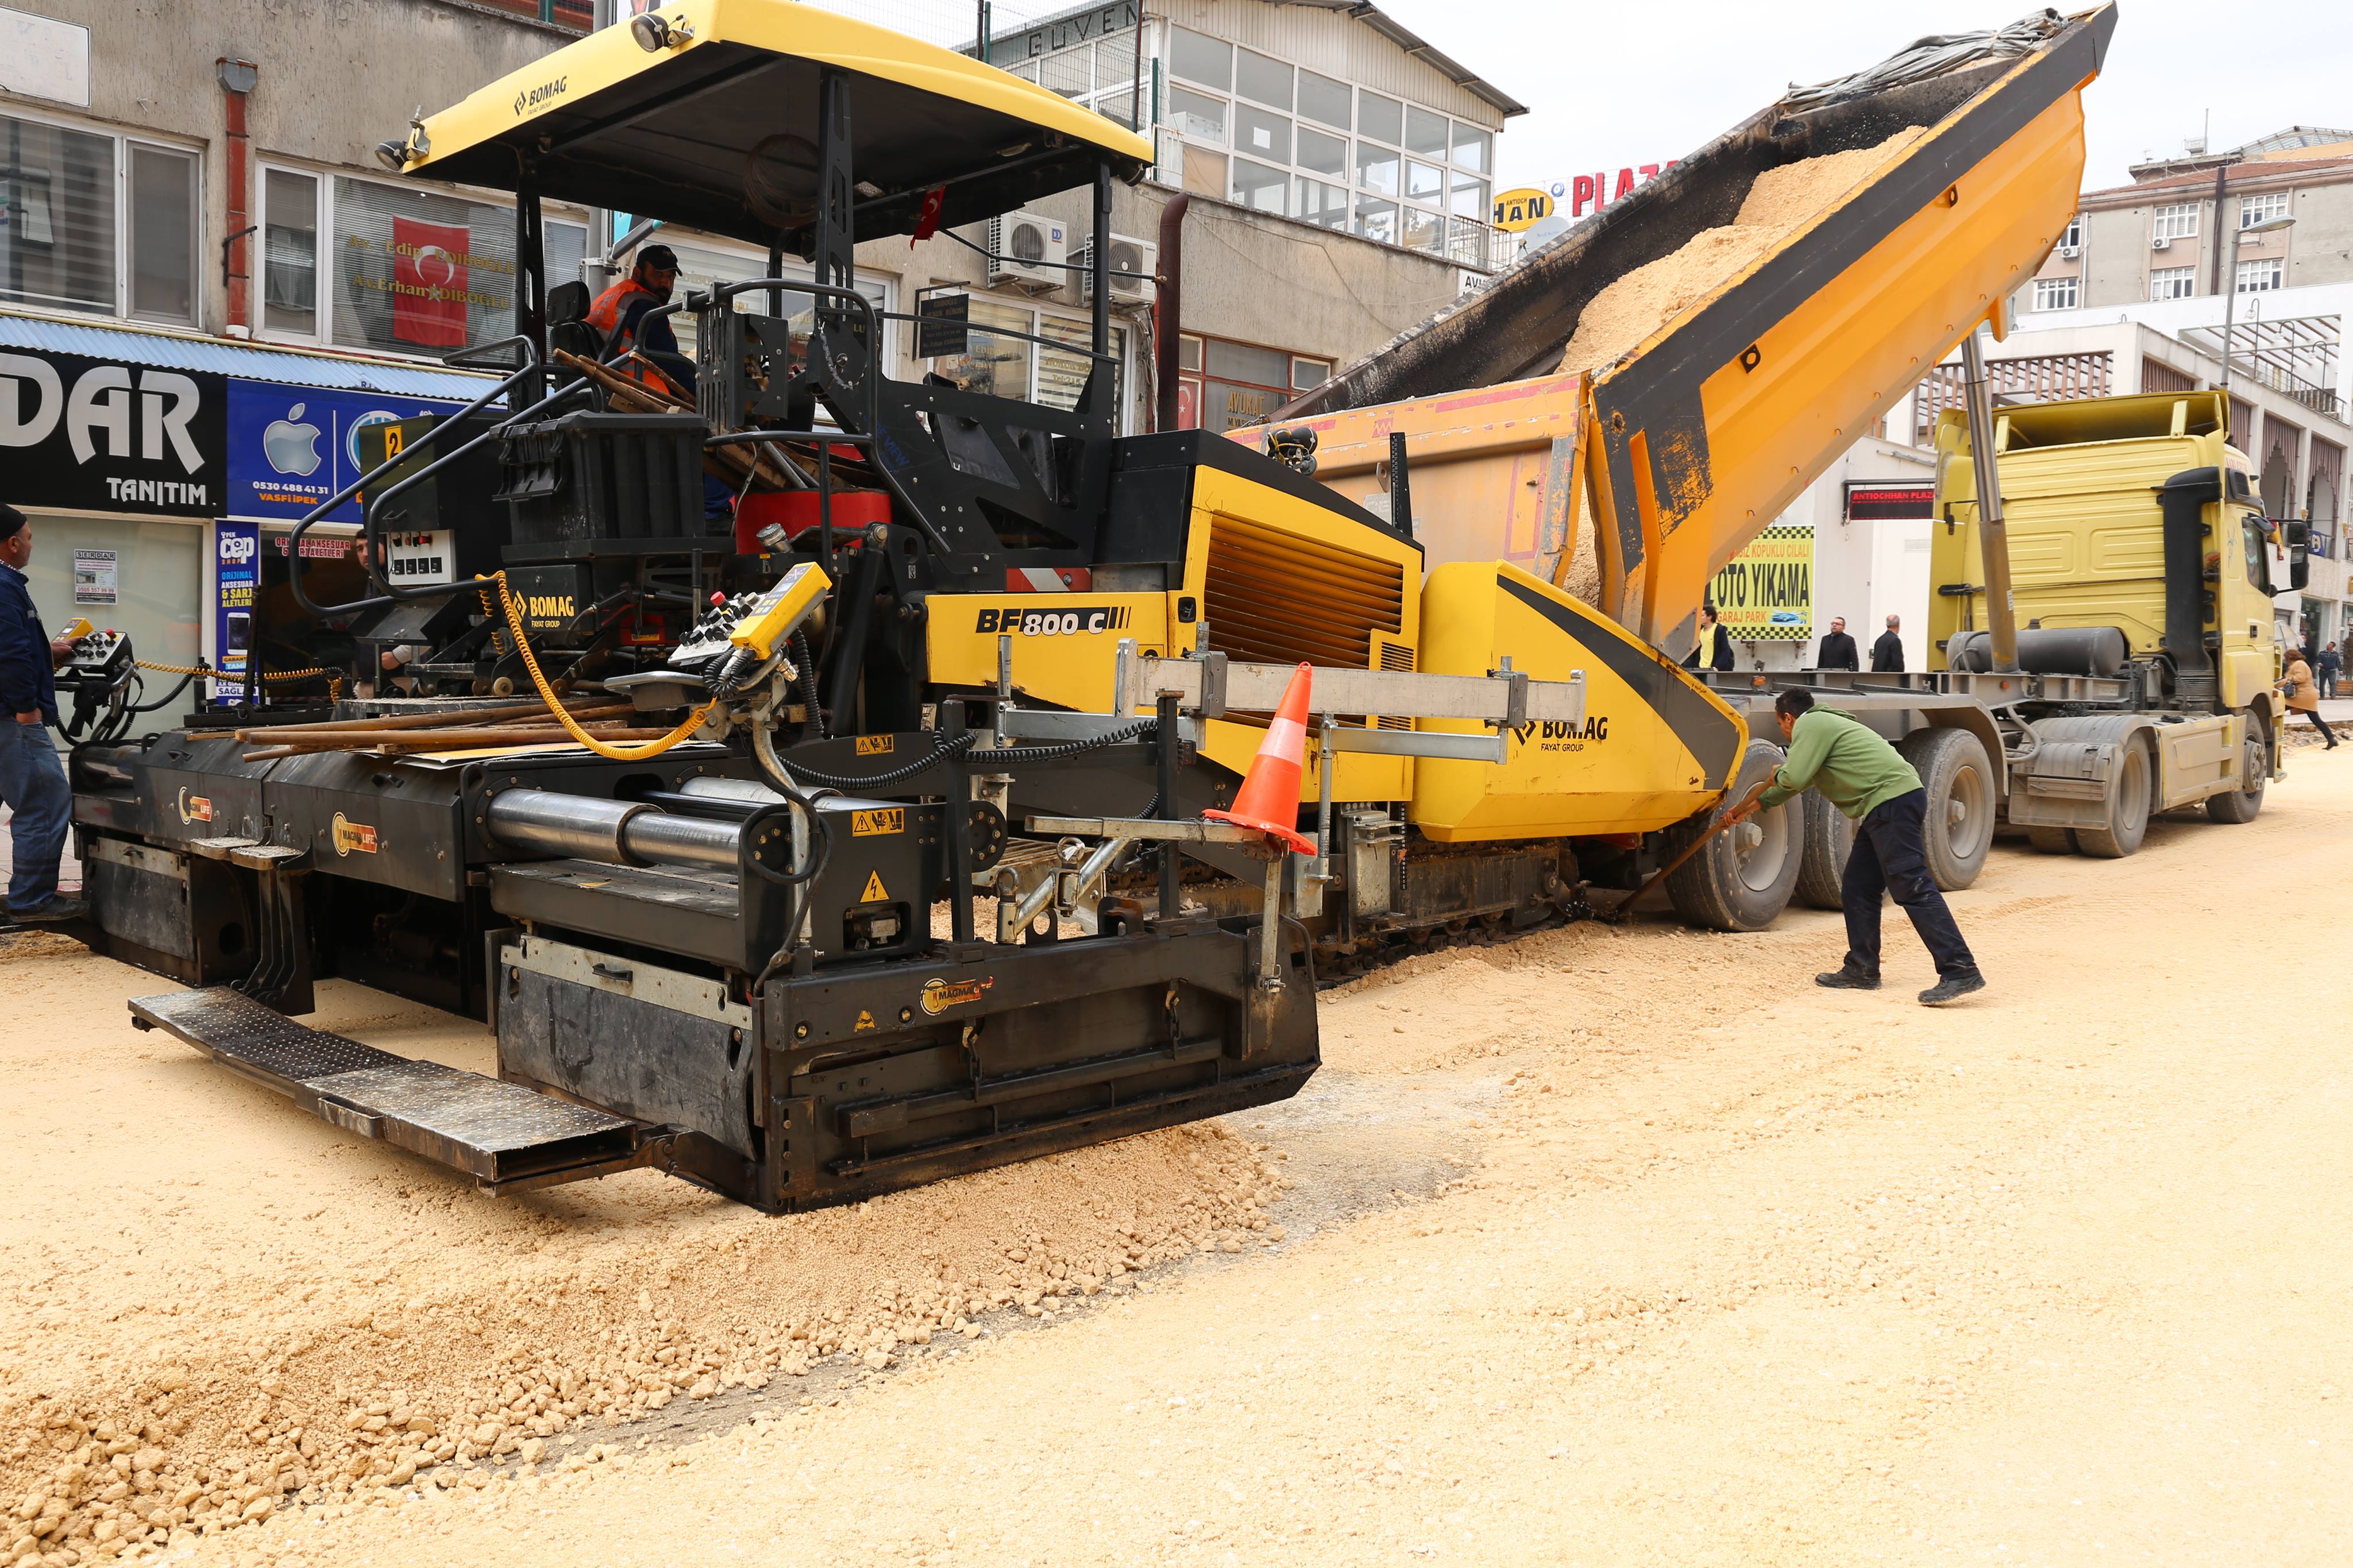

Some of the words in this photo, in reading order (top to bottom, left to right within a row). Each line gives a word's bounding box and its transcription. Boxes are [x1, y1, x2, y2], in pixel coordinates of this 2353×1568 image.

[529, 75, 567, 107] BOMAG
[1506, 197, 1527, 206] ANTIOCH
[348, 235, 373, 250] Av.
[385, 239, 423, 260] Edip
[1227, 390, 1264, 416] AVUKAT
[0, 352, 205, 475] DAR
[106, 477, 206, 506] TANITIM
[252, 481, 280, 491] 0530
[281, 484, 303, 492] 488
[303, 485, 315, 493] 41
[317, 486, 329, 495] 31
[311, 539, 350, 550] AKSESUAR
[1752, 542, 1785, 558] KÖPÜKLÜ
[221, 580, 253, 589] AKSESUAR
[1718, 563, 1746, 607] OTO
[1752, 563, 1810, 607] YIKAMA
[222, 589, 229, 599] &
[529, 596, 575, 617] BOMAG
[545, 620, 561, 628] GROUP
[1716, 611, 1743, 623] GARAJ
[1745, 611, 1767, 623] PARK
[1541, 743, 1560, 752] FAYAT
[1562, 744, 1584, 752] GROUP
[939, 987, 973, 1000] MAGMA
